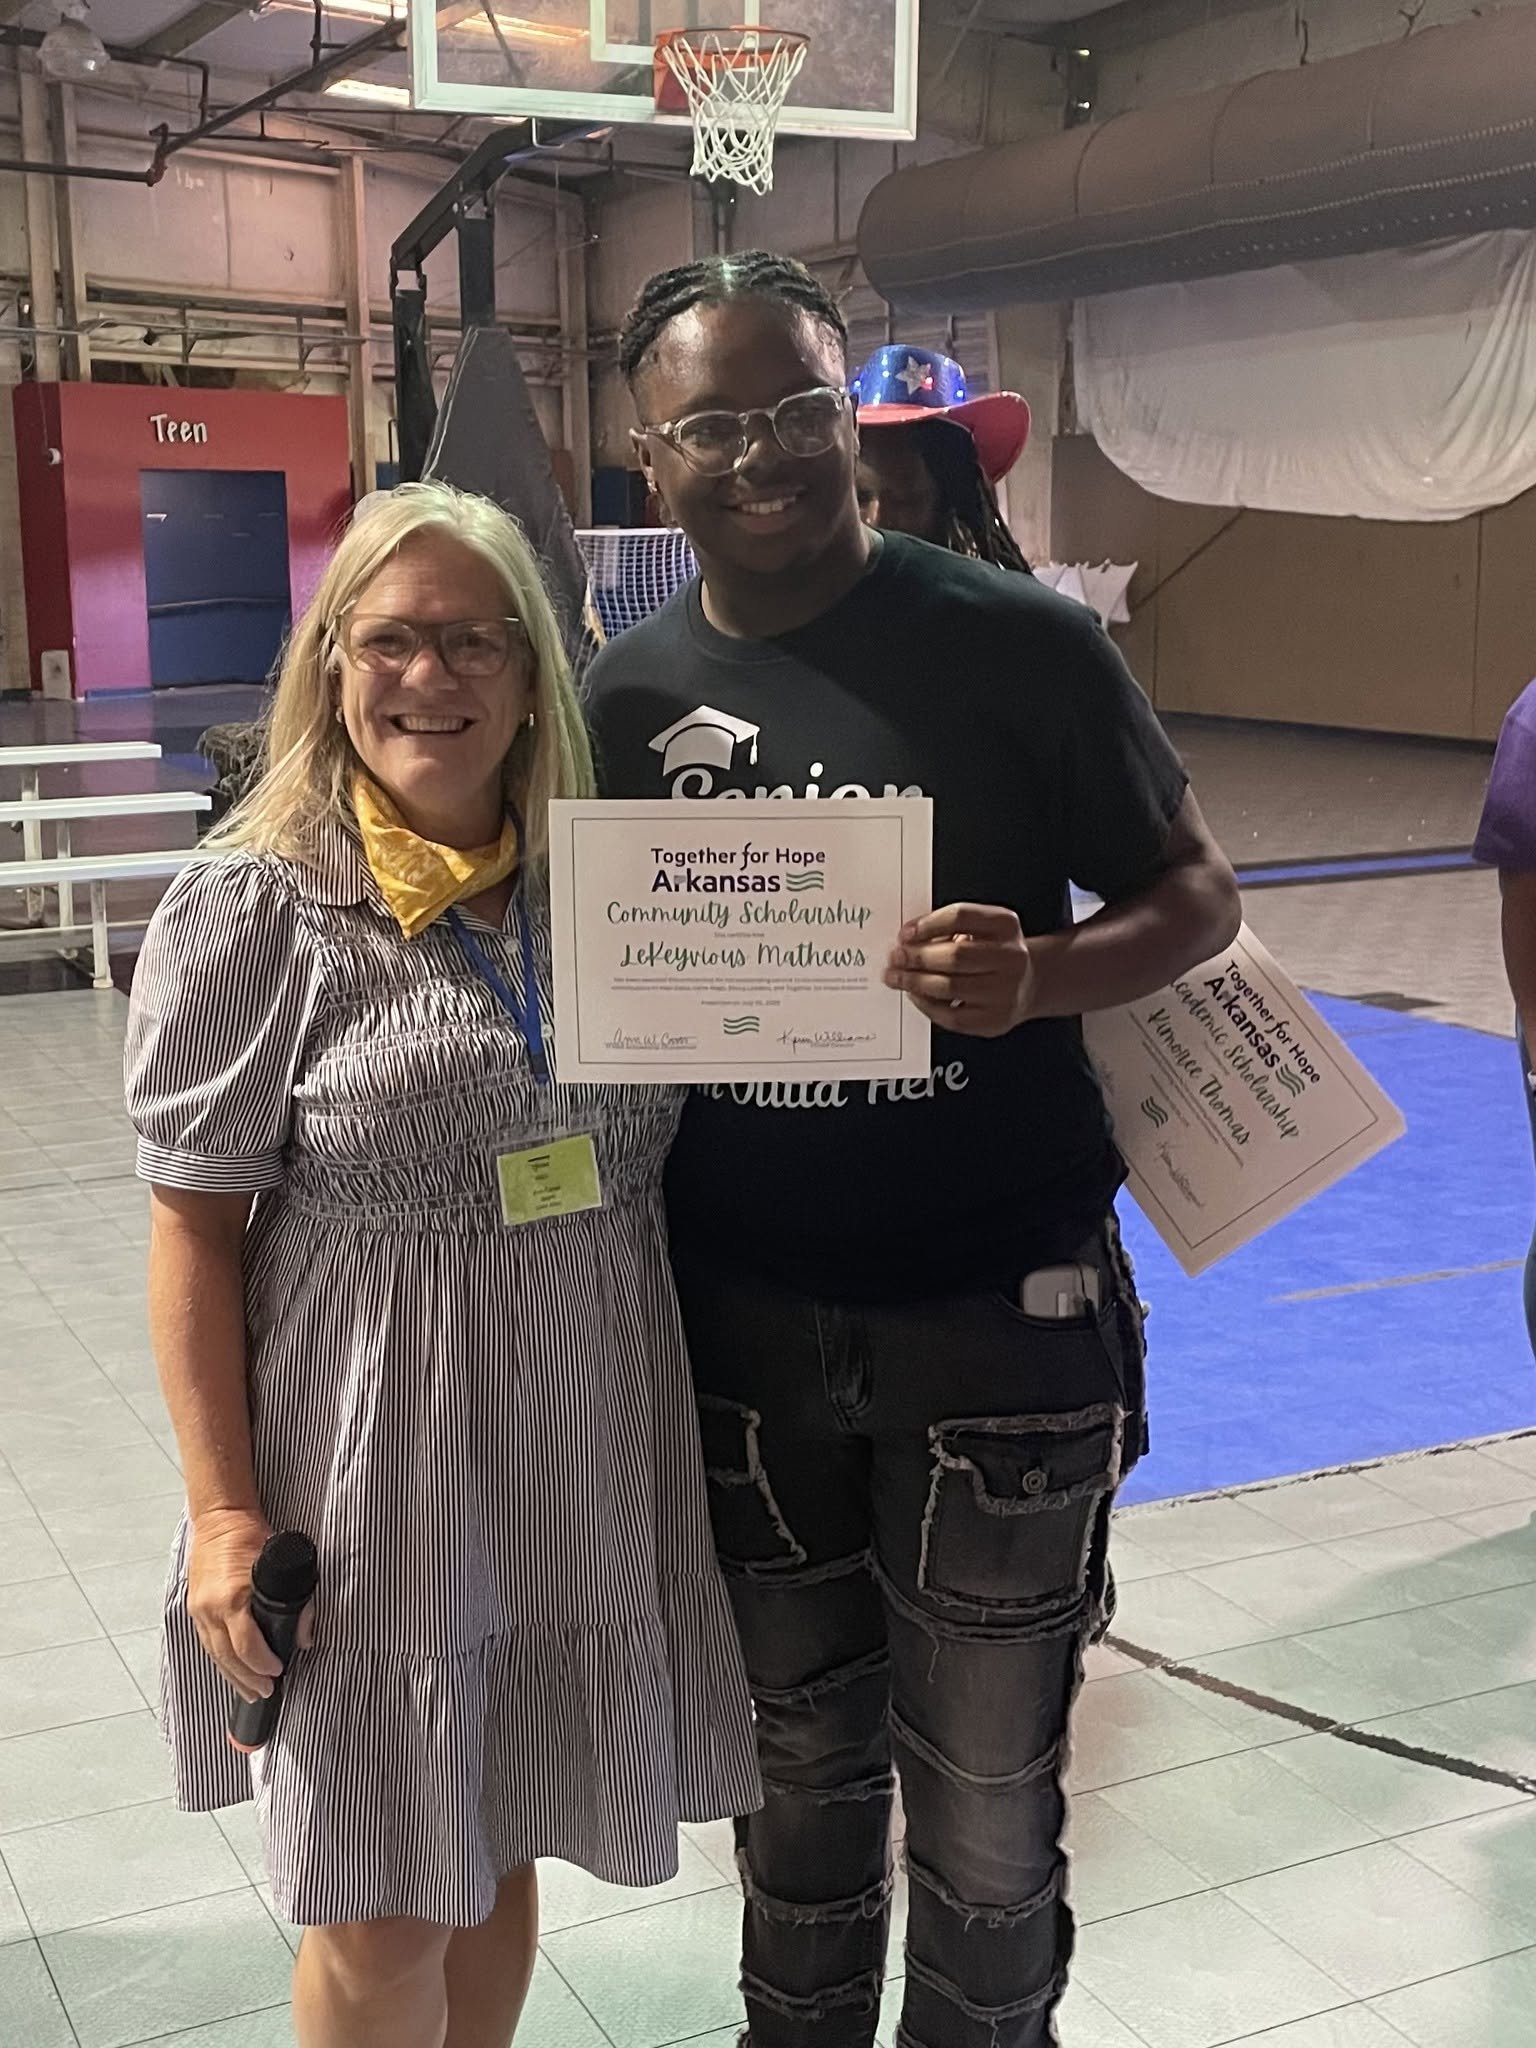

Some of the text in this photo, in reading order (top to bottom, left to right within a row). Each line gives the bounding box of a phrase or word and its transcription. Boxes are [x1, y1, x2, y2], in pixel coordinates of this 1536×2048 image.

[150, 413, 208, 443] Teen
[650, 841, 826, 871] Together for Hope
[651, 867, 781, 893] Arkansas
[607, 898, 871, 929] Community Scholarship
[757, 941, 866, 969] Mathews
[1203, 976, 1281, 1068] Arkansas
[1225, 960, 1321, 1084] Together for Hope
[1170, 981, 1229, 1045] cademic
[1224, 1044, 1300, 1140] Scholarship
[1199, 1072, 1251, 1145] Thomas
